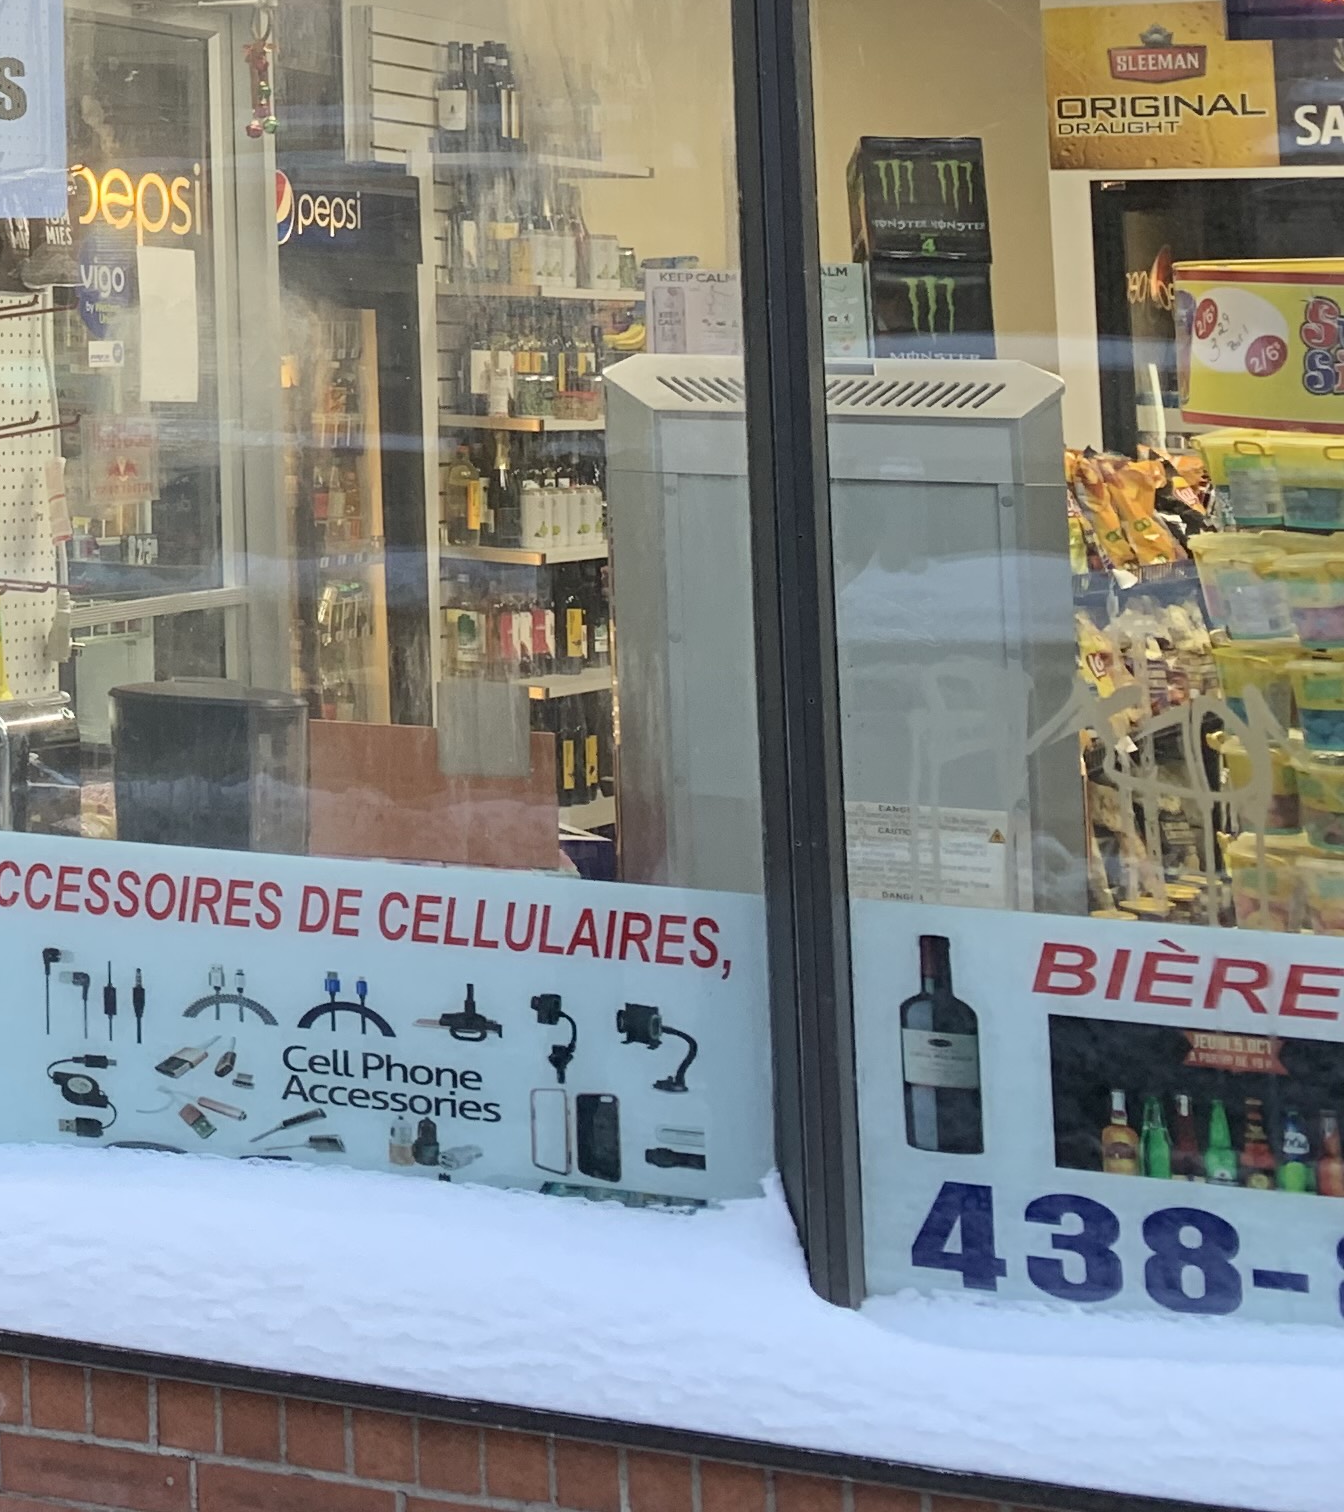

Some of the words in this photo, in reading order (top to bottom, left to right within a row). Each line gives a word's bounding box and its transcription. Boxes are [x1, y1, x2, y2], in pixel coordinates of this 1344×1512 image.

[1115, 51, 1201, 74] SLEEMAN
[1056, 92, 1268, 120] ORIGINAL
[1057, 120, 1180, 136] DRAUGHT
[297, 190, 362, 238] pepsi
[80, 256, 126, 298] vigo
[659, 271, 694, 284] KEEP
[696, 272, 737, 284] CALM
[298, 885, 364, 937] DE
[378, 891, 732, 980] CELLULAIRES,
[1031, 939, 1344, 1021] BIÈRE
[282, 1044, 355, 1078] Cell
[361, 1052, 483, 1091] Phone
[281, 1074, 502, 1123] Accessories
